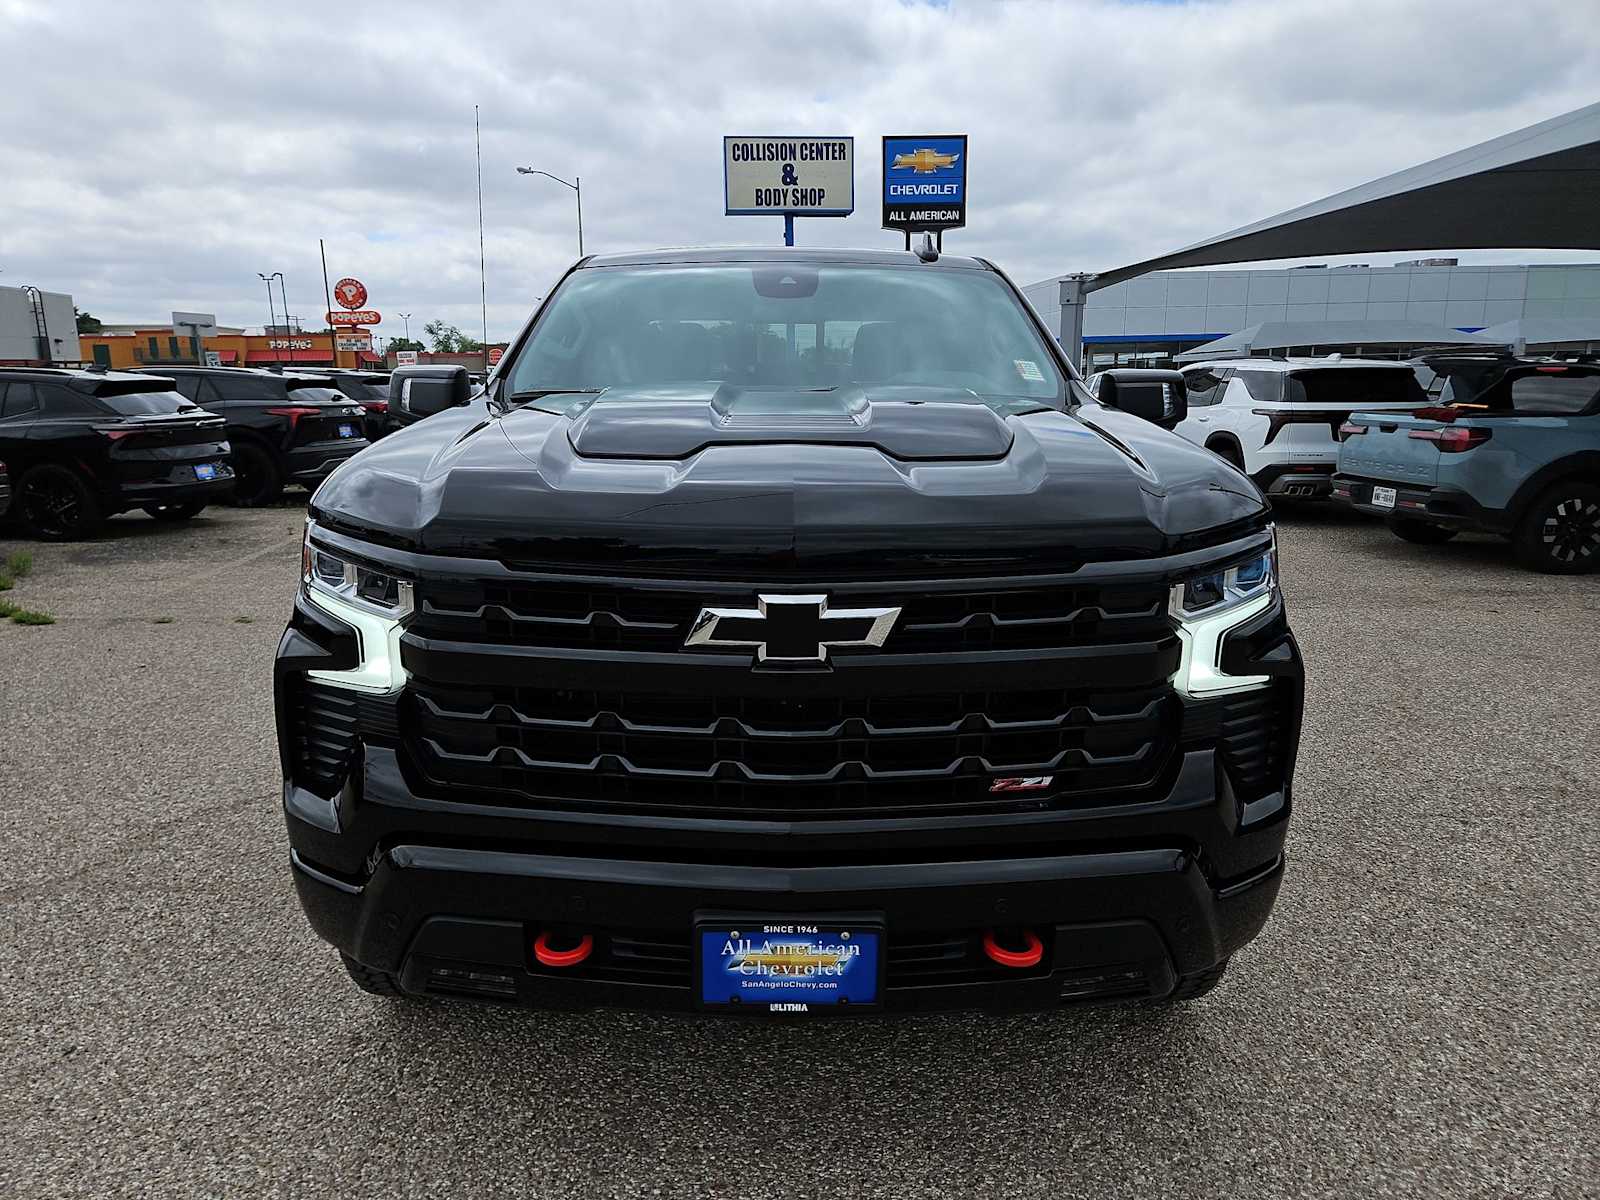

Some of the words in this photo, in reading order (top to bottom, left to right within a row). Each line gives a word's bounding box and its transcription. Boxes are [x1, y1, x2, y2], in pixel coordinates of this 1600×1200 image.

[732, 142, 797, 162] COLLISION
[800, 142, 847, 161] CENTER
[781, 163, 799, 186] &
[755, 188, 791, 207] BODY
[792, 187, 826, 207] SHOP
[889, 184, 959, 196] CHEVROLET
[889, 210, 907, 221] ALL
[909, 210, 960, 221] AMERICAN
[763, 925, 794, 934] SINCE
[796, 925, 819, 934] 1946
[721, 939, 751, 956] All
[760, 940, 861, 956] American
[739, 960, 844, 976] Chevrolet
[741, 980, 838, 990] SanAngeloChevy.com
[778, 1003, 808, 1012] LITHIA
